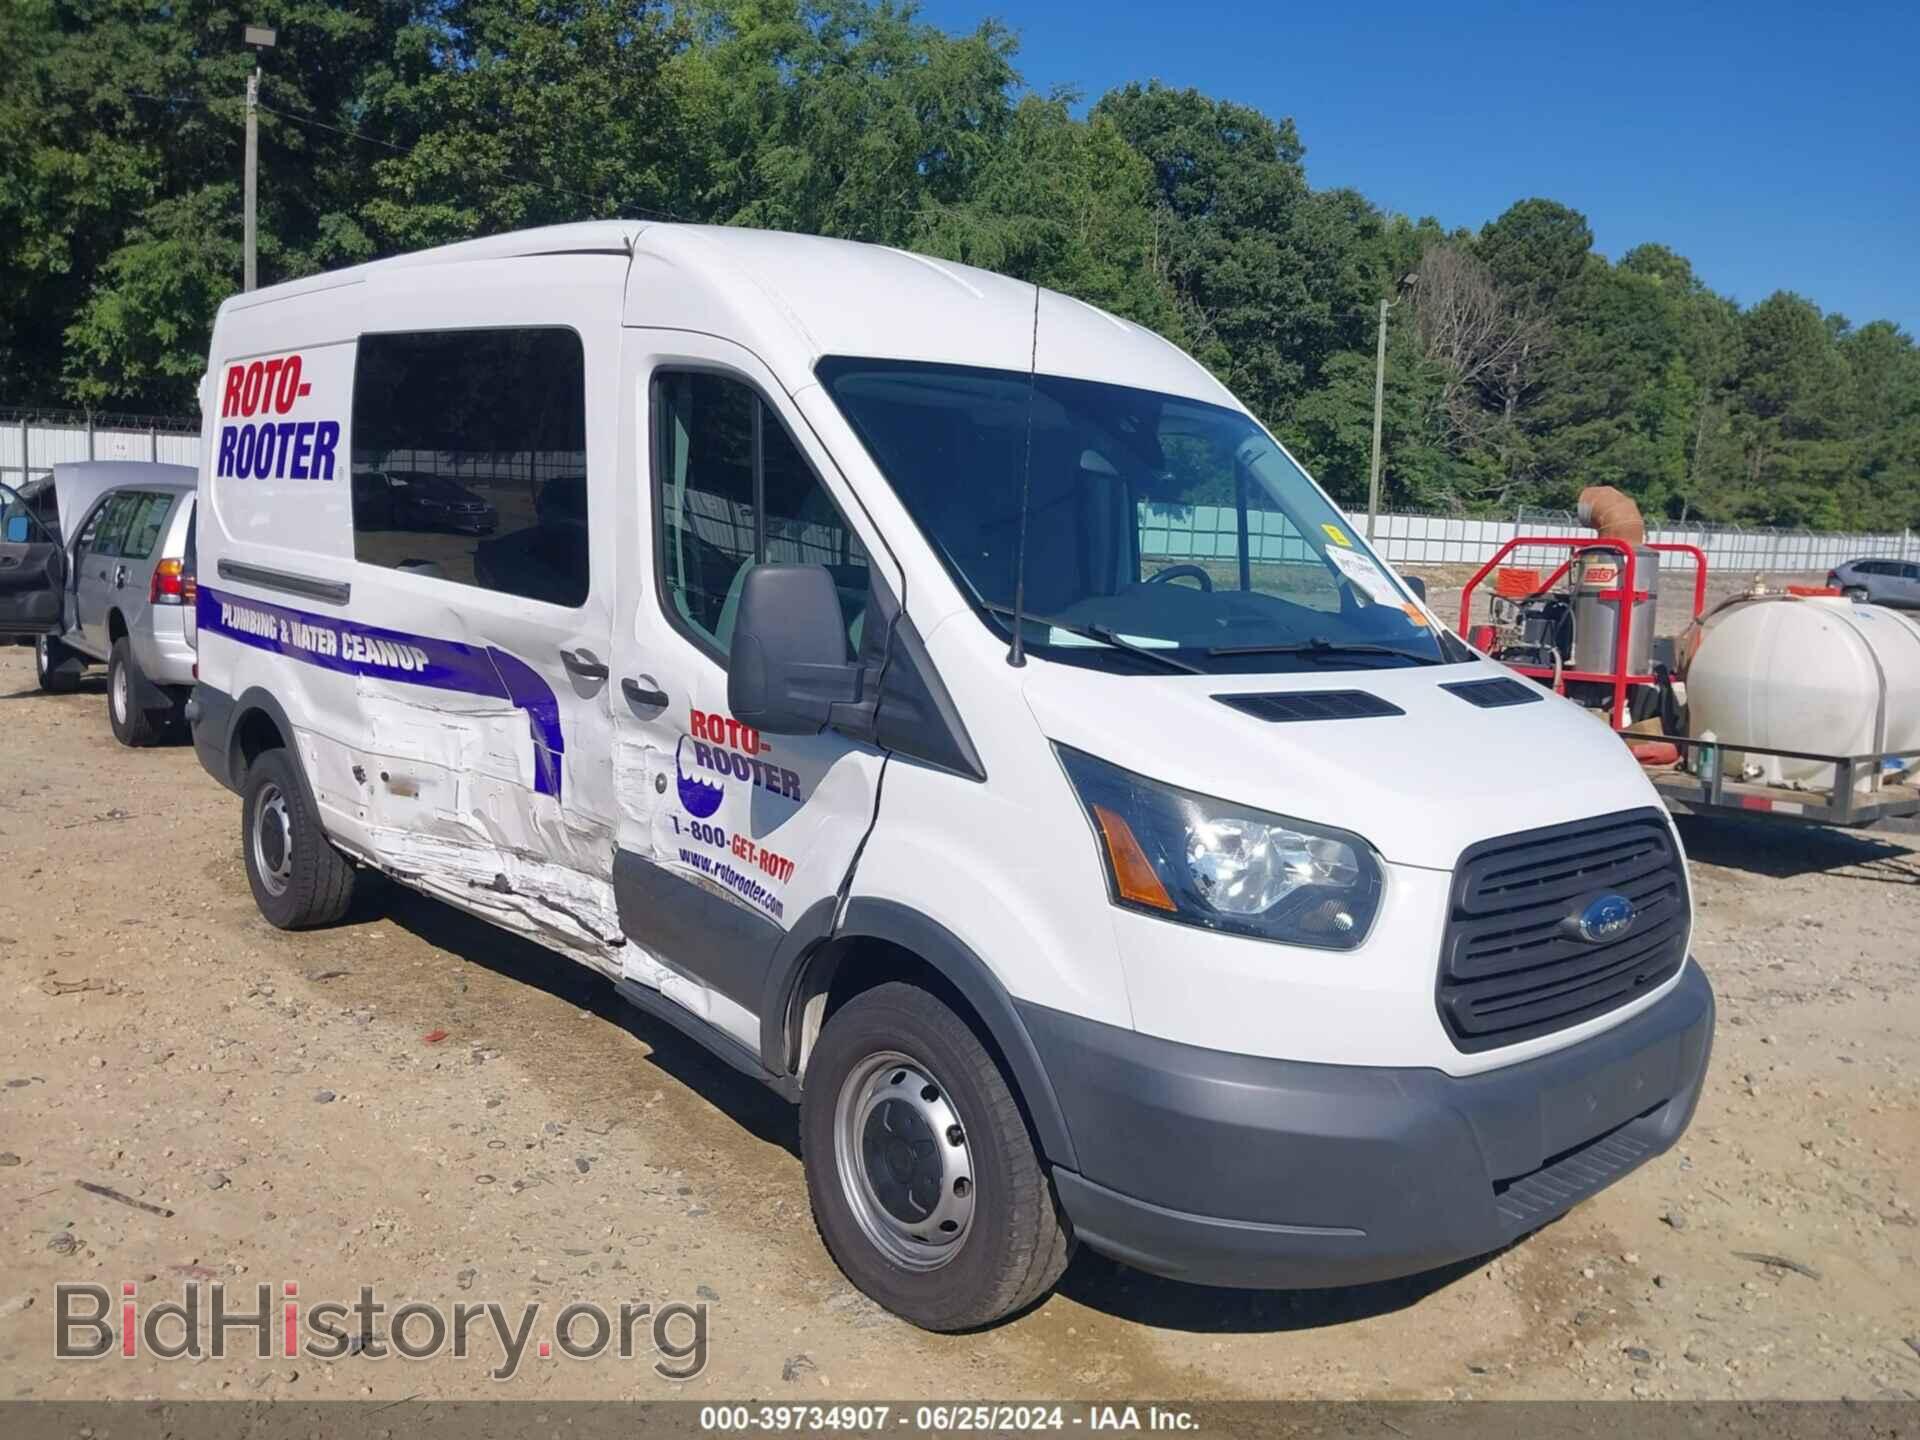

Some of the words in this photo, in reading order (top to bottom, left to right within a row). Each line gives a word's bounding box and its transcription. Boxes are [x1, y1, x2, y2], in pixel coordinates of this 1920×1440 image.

[222, 355, 311, 417] ROTO-
[217, 420, 340, 480] ROOTER
[221, 602, 278, 640] PLUMBING
[280, 619, 290, 643] &
[291, 621, 337, 656] WATER
[694, 740, 801, 802] ROOTER
[679, 848, 784, 919] www.rotorooter.com
